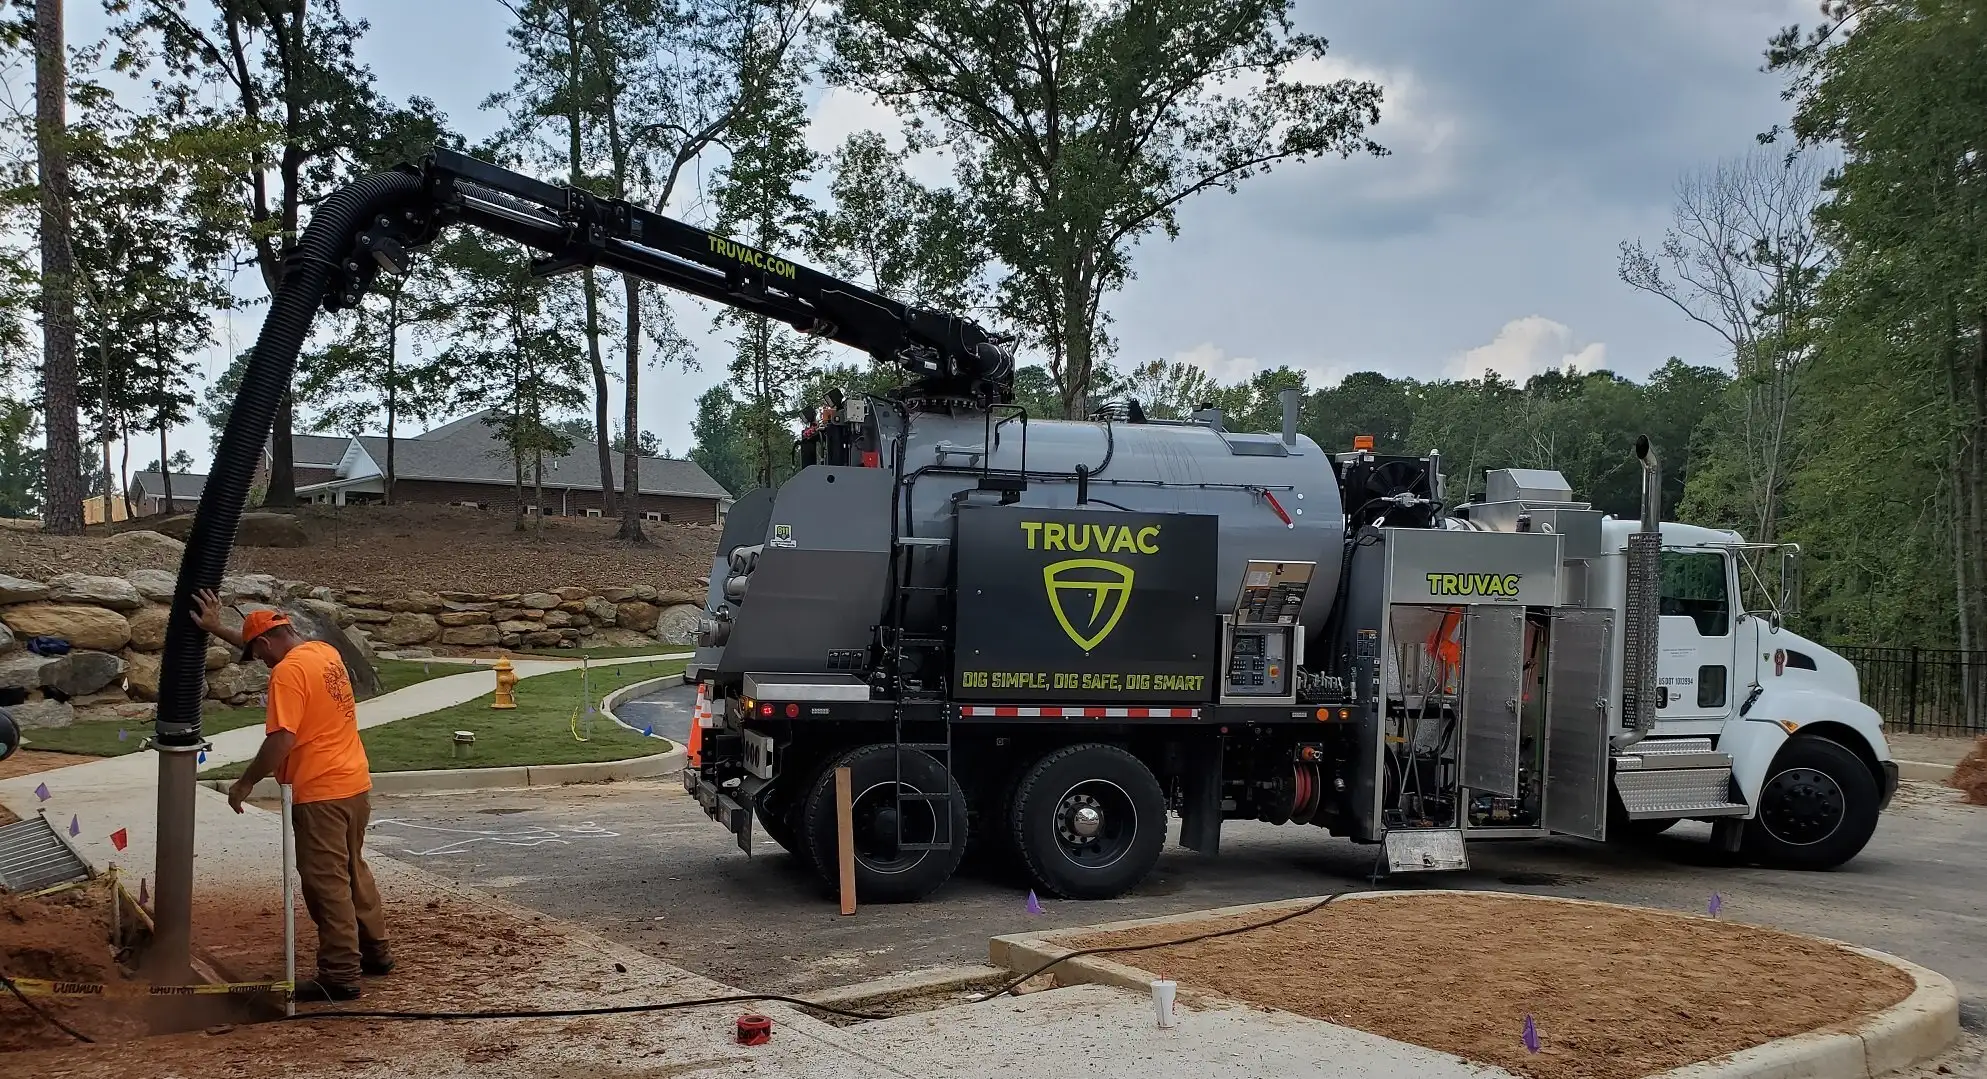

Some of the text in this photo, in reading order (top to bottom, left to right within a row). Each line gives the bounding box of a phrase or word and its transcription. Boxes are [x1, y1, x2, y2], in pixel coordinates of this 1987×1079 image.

[707, 234, 796, 280] TRUVAC.COM
[776, 526, 790, 535] 811
[1020, 521, 1160, 554] TRUVAC
[1426, 573, 1520, 597] TRUVAC
[962, 671, 1205, 692] DIG SIMPLE, DIG SAFE, DIG SMART
